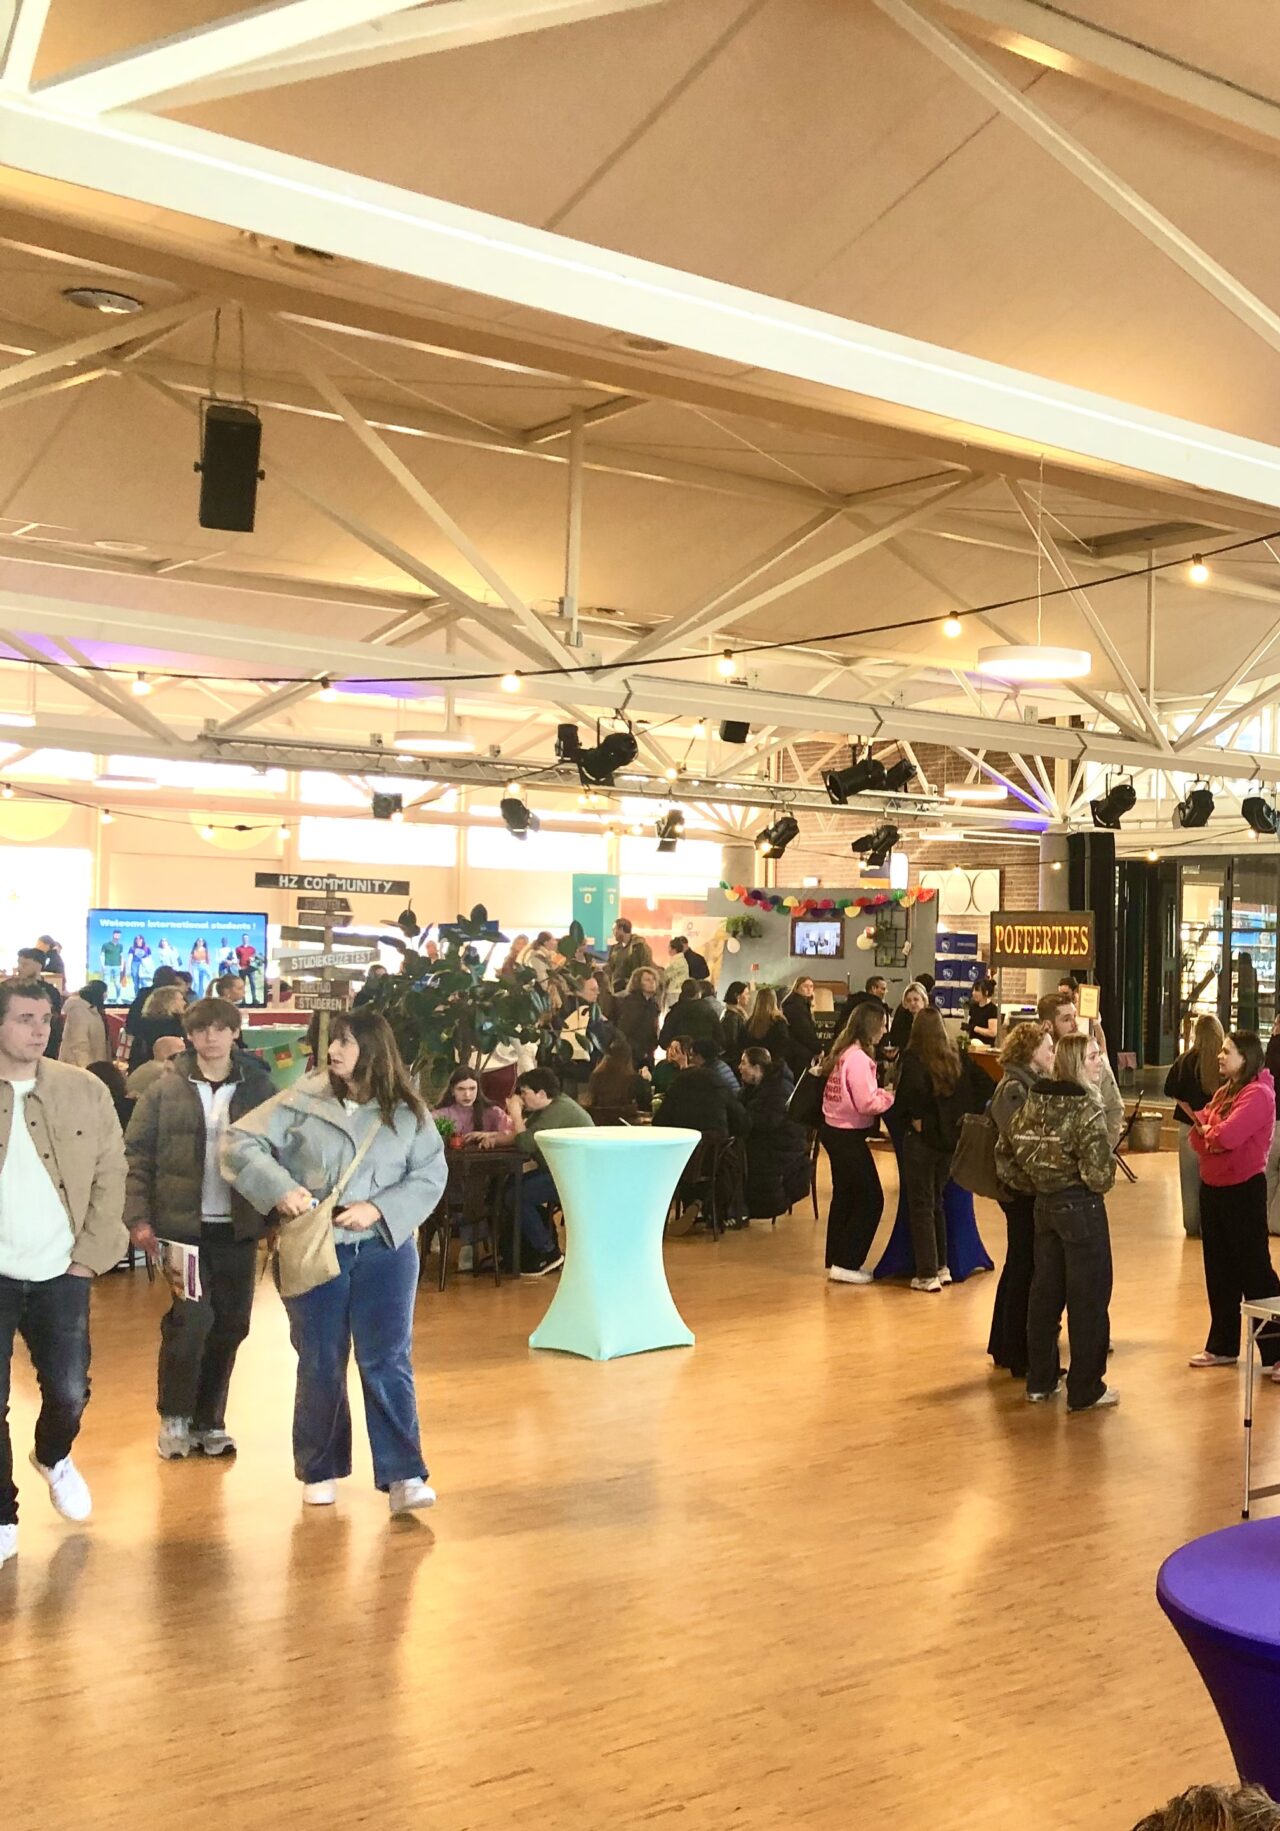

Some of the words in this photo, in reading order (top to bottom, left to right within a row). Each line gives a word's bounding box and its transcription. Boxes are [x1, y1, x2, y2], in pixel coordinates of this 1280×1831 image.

[279, 875, 298, 888] HZ
[304, 876, 393, 893] COMMUNITY
[995, 925, 1089, 955] POFFERTJES
[299, 997, 342, 1011] STUDEREN
